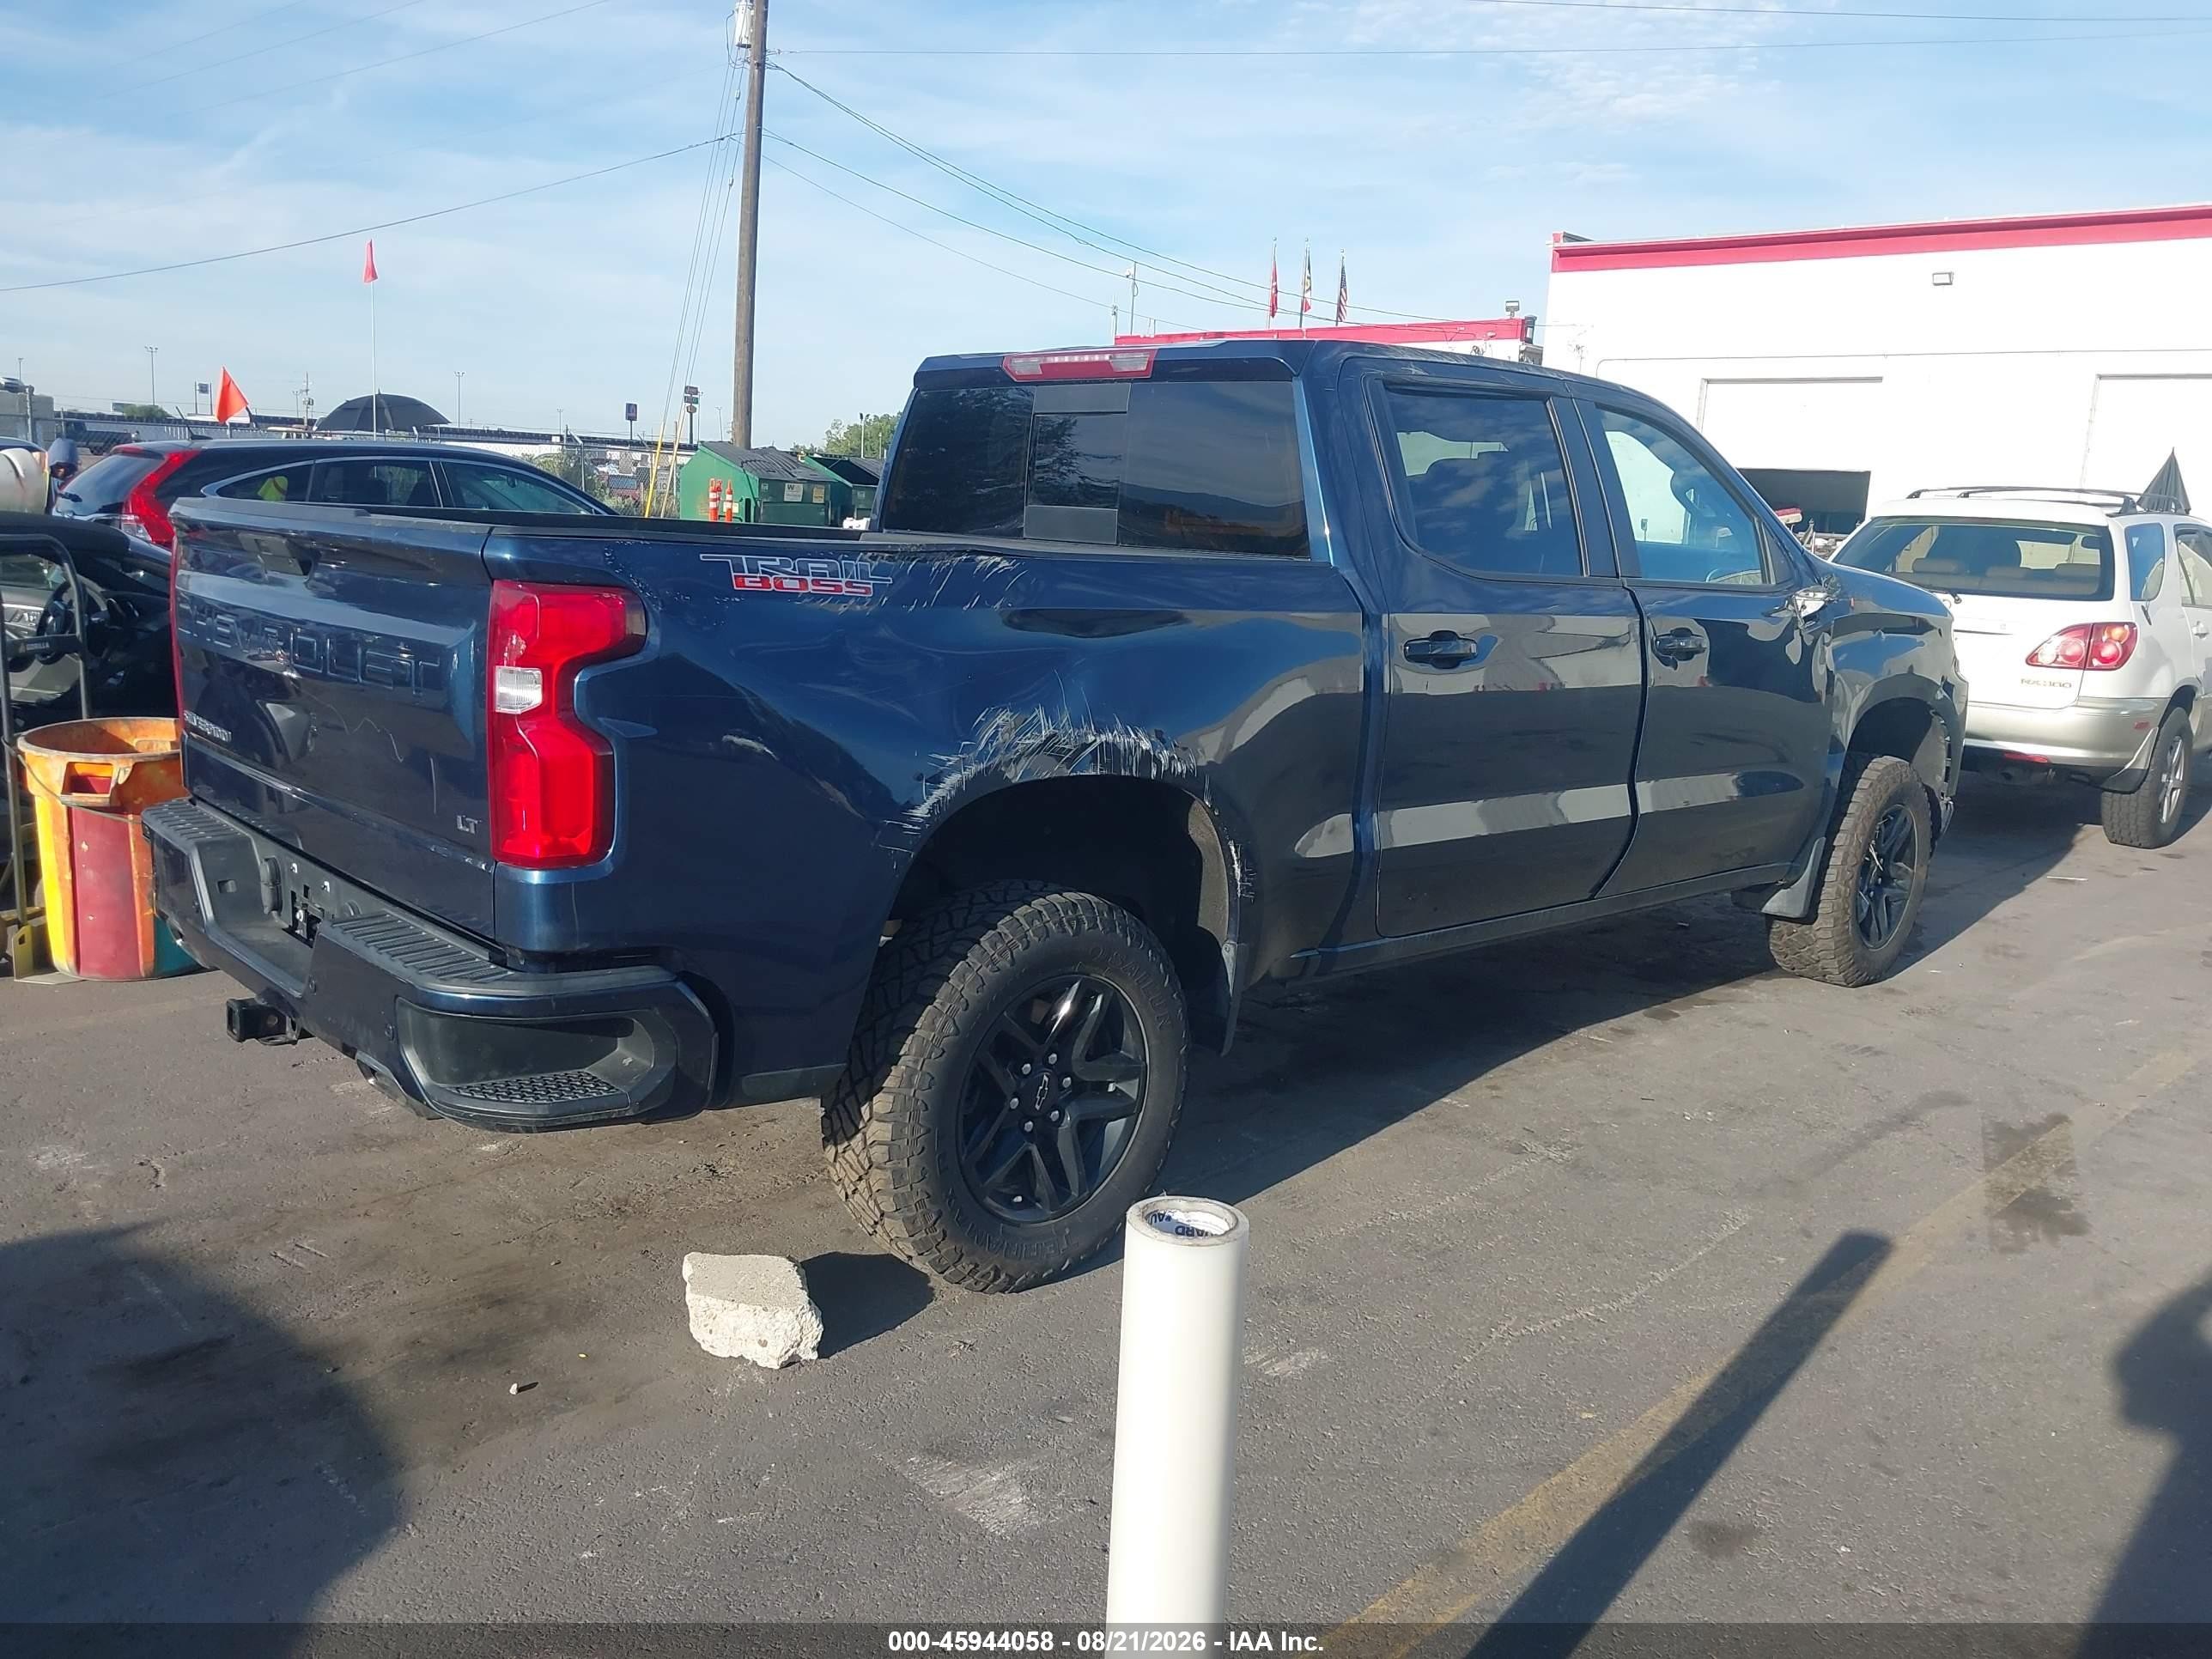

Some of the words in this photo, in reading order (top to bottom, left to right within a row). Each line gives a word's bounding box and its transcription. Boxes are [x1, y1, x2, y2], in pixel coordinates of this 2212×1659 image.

[699, 554, 893, 584] TRAIL
[733, 573, 873, 597] BOSS
[456, 815, 479, 835] LT
